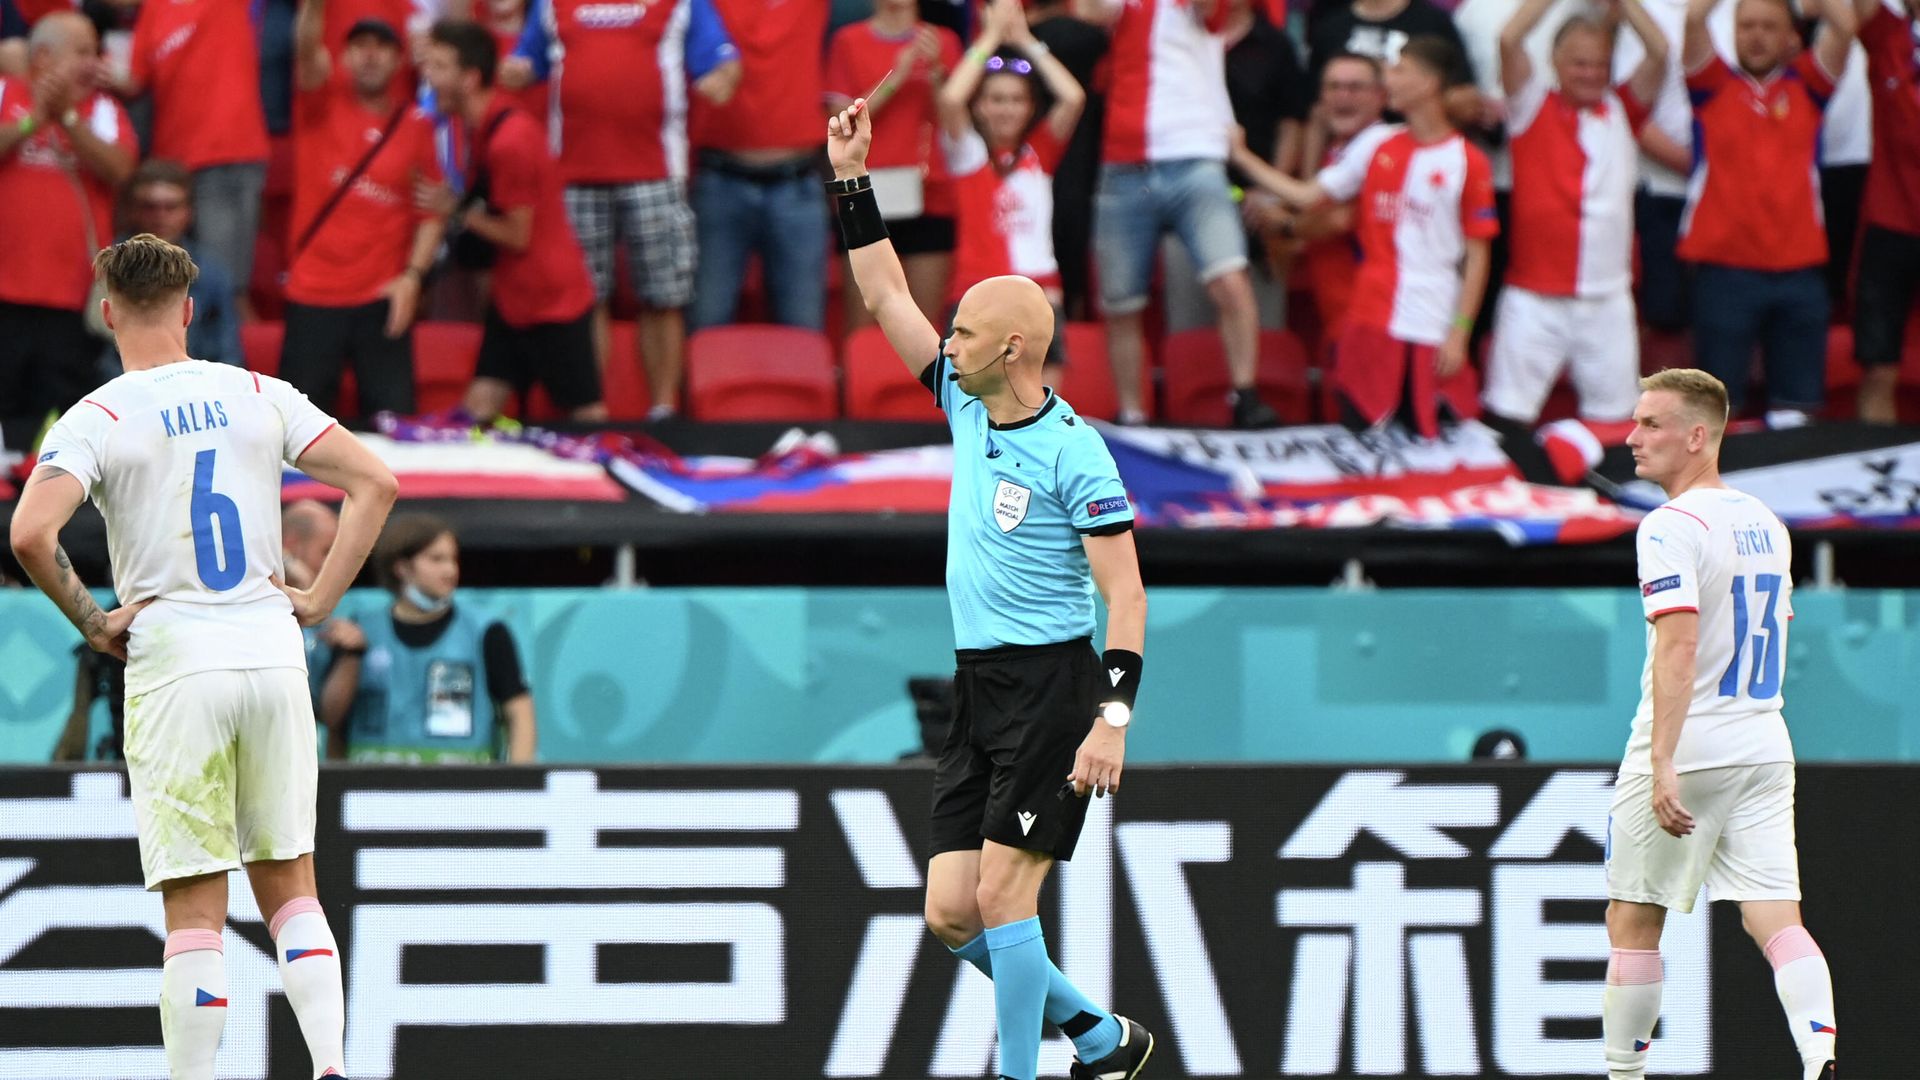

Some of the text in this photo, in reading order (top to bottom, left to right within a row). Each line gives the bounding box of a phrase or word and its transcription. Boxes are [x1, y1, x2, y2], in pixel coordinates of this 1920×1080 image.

[161, 400, 228, 438] KALAS
[1002, 488, 1023, 500] UEFA
[1000, 502, 1019, 512] MATCH
[1099, 500, 1127, 511] RESPECT
[190, 449, 247, 592] 6
[995, 508, 1019, 521] OFFICIAL
[1718, 573, 1783, 700] 13
